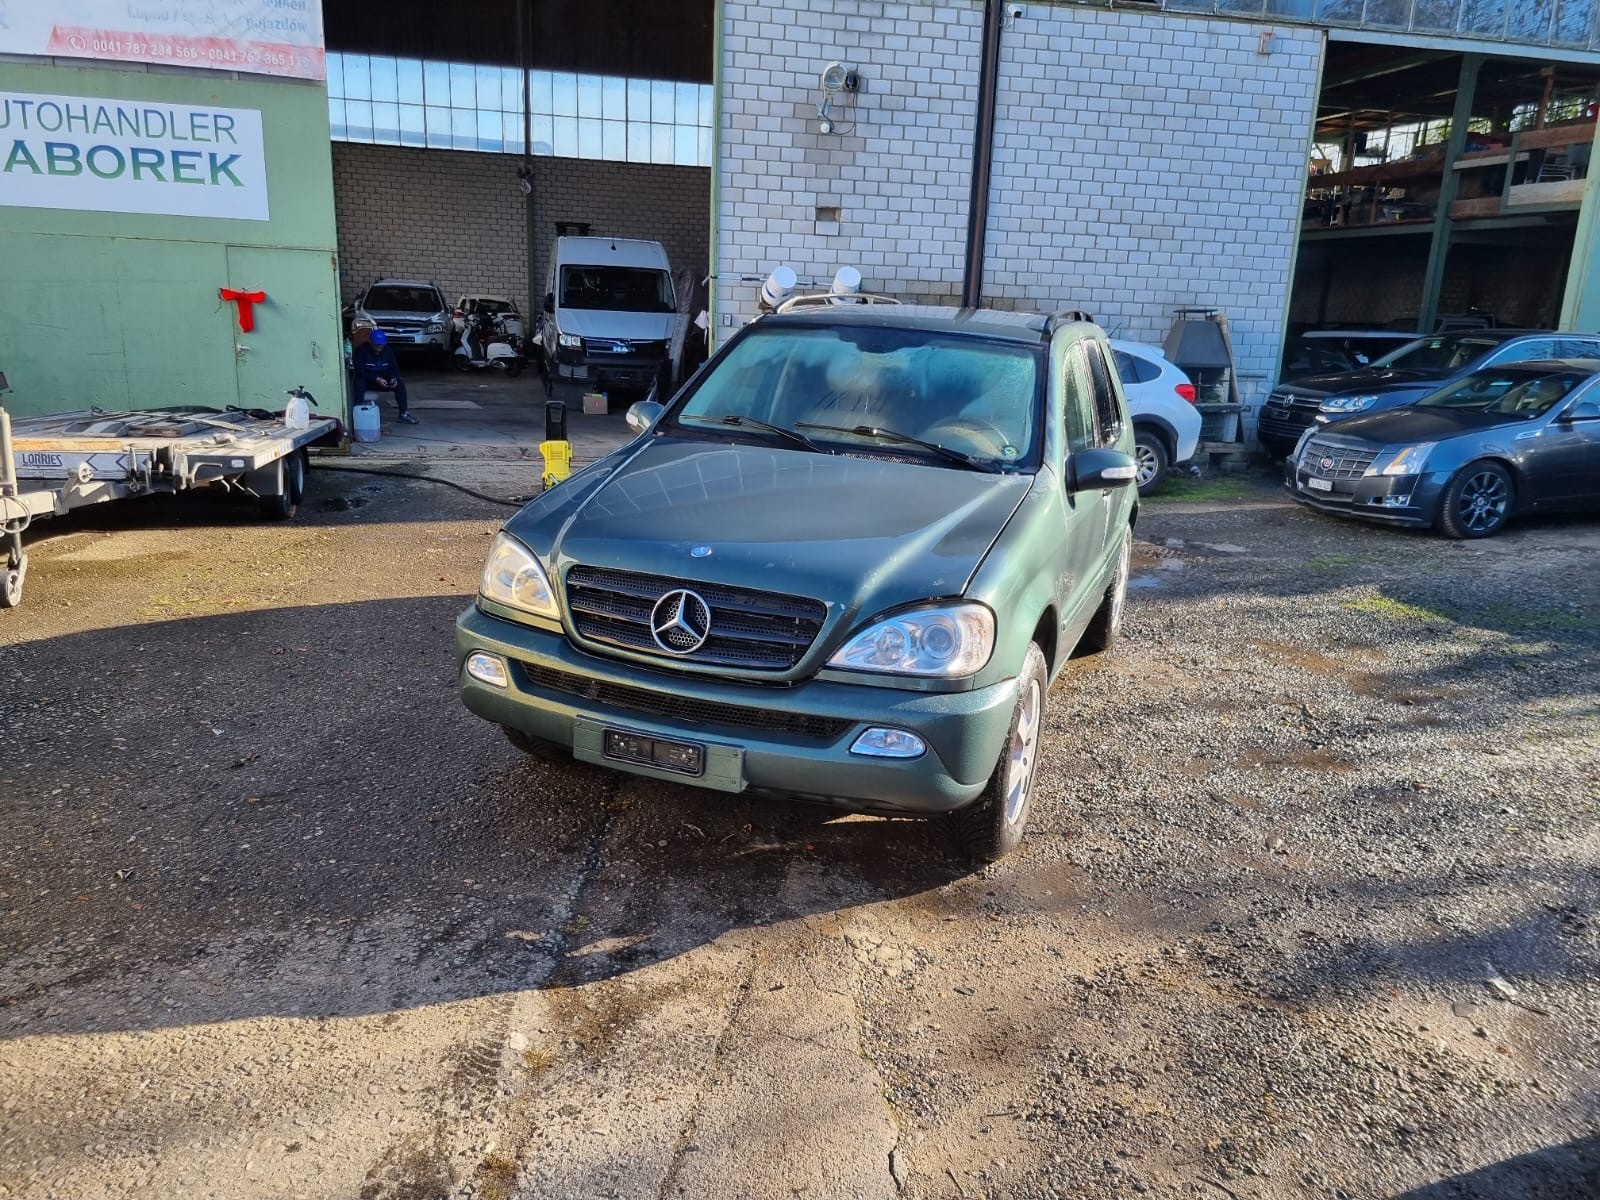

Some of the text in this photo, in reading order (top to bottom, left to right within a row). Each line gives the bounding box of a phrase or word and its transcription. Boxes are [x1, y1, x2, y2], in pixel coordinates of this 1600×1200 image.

[93, 40, 121, 52] 0041
[127, 42, 147, 54] 787
[176, 46, 198, 58] 566
[208, 48, 236, 62] 0041
[3, 139, 245, 187] ABOREK
[22, 453, 62, 467] LORRIES
